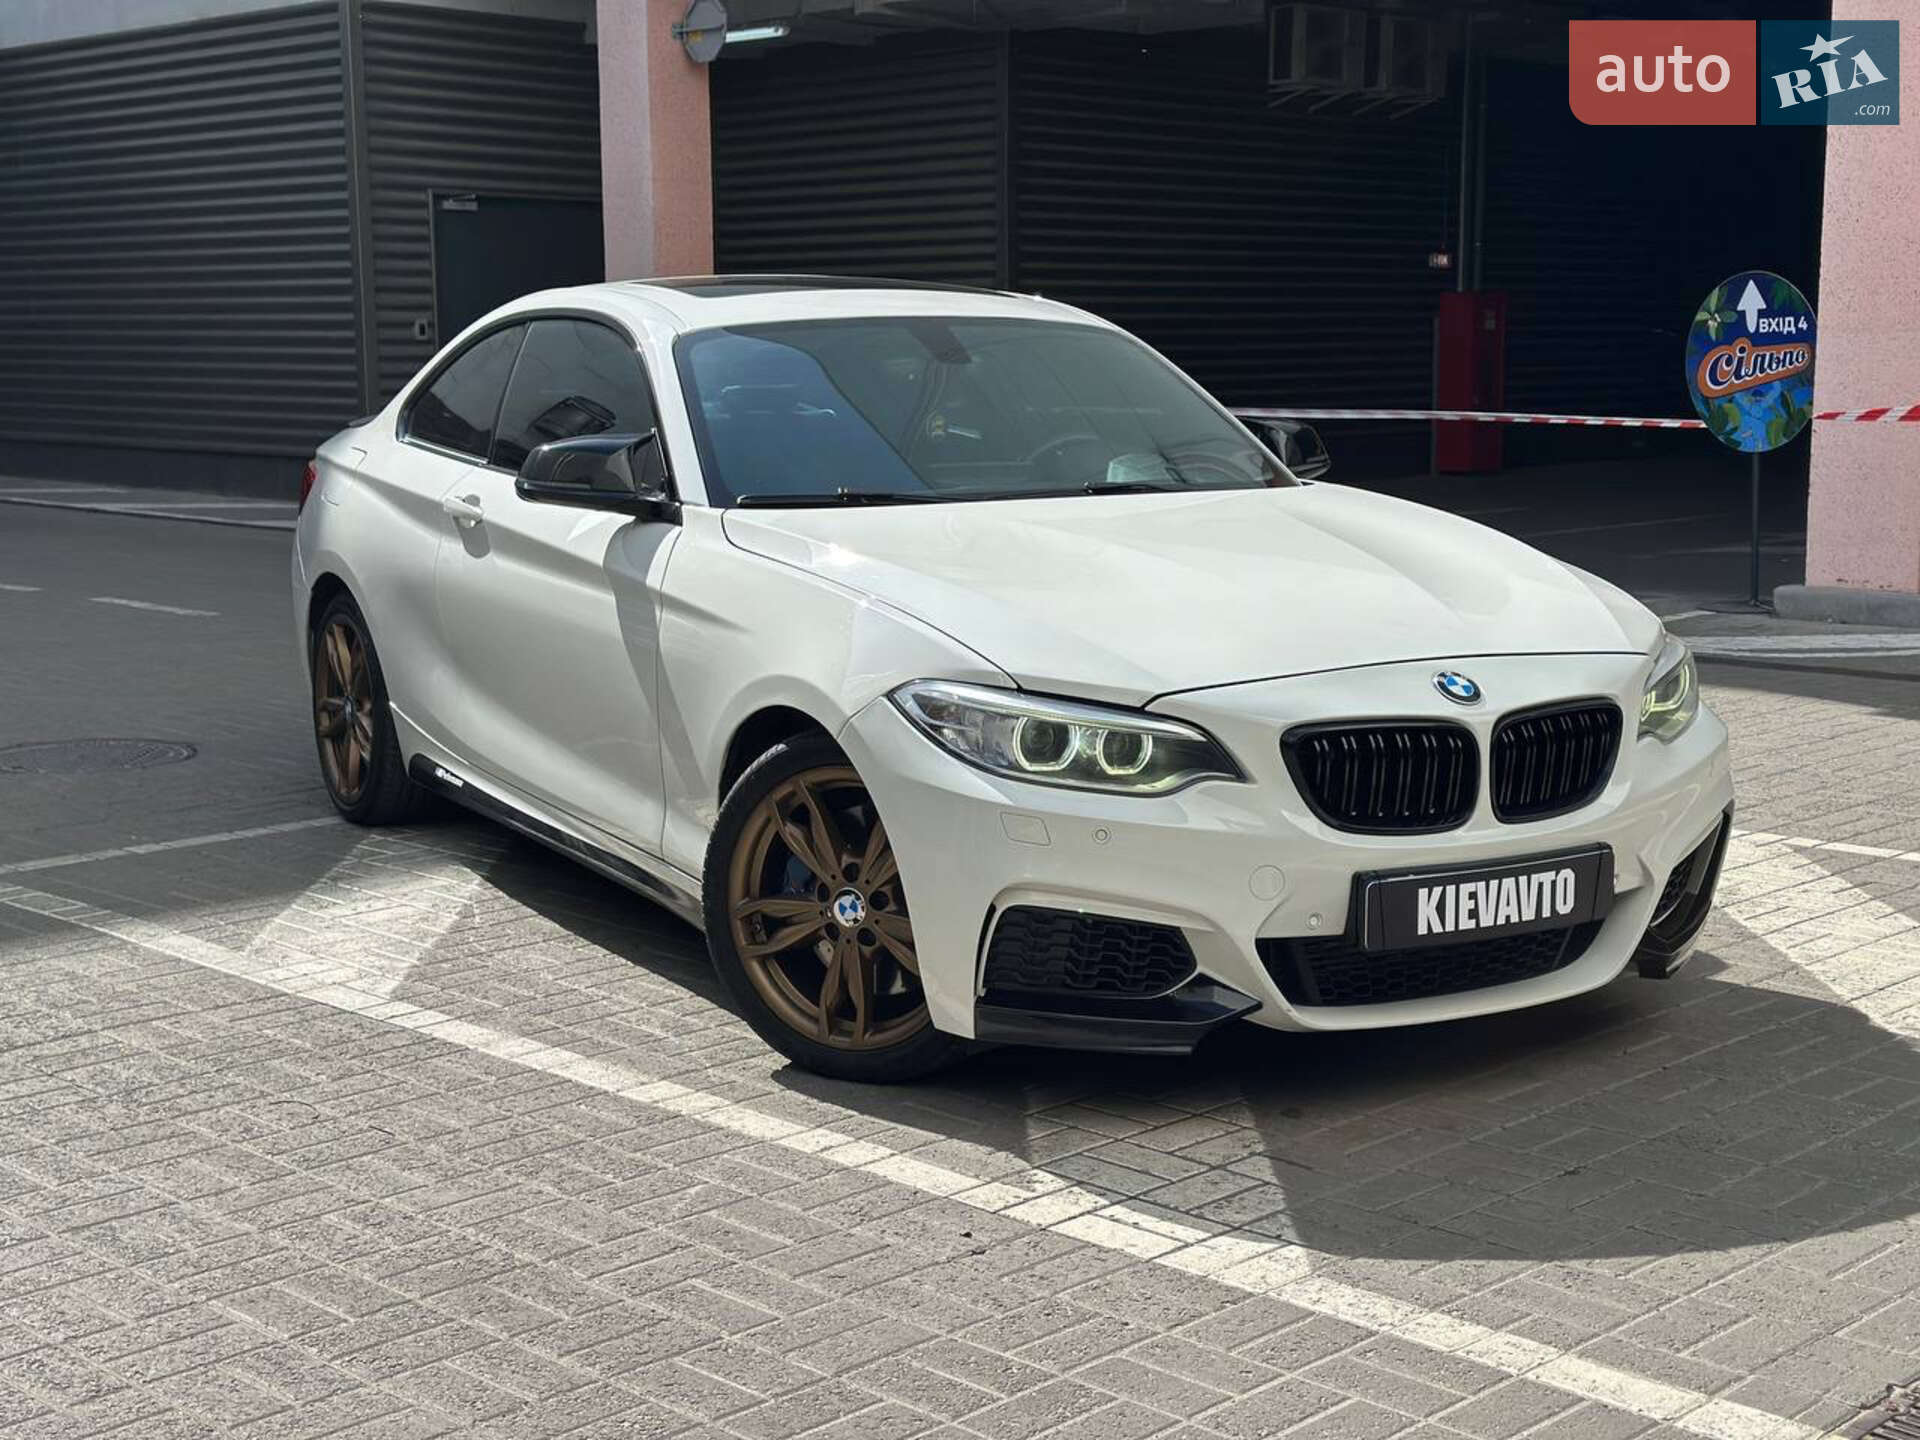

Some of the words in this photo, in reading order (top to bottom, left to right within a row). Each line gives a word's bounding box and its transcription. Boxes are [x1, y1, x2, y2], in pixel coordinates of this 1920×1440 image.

[1759, 316, 1796, 334] ВХІД
[1797, 315, 1808, 331] 4
[1705, 344, 1809, 390] Сільпо
[1416, 867, 1576, 936] KIEVAVTO
